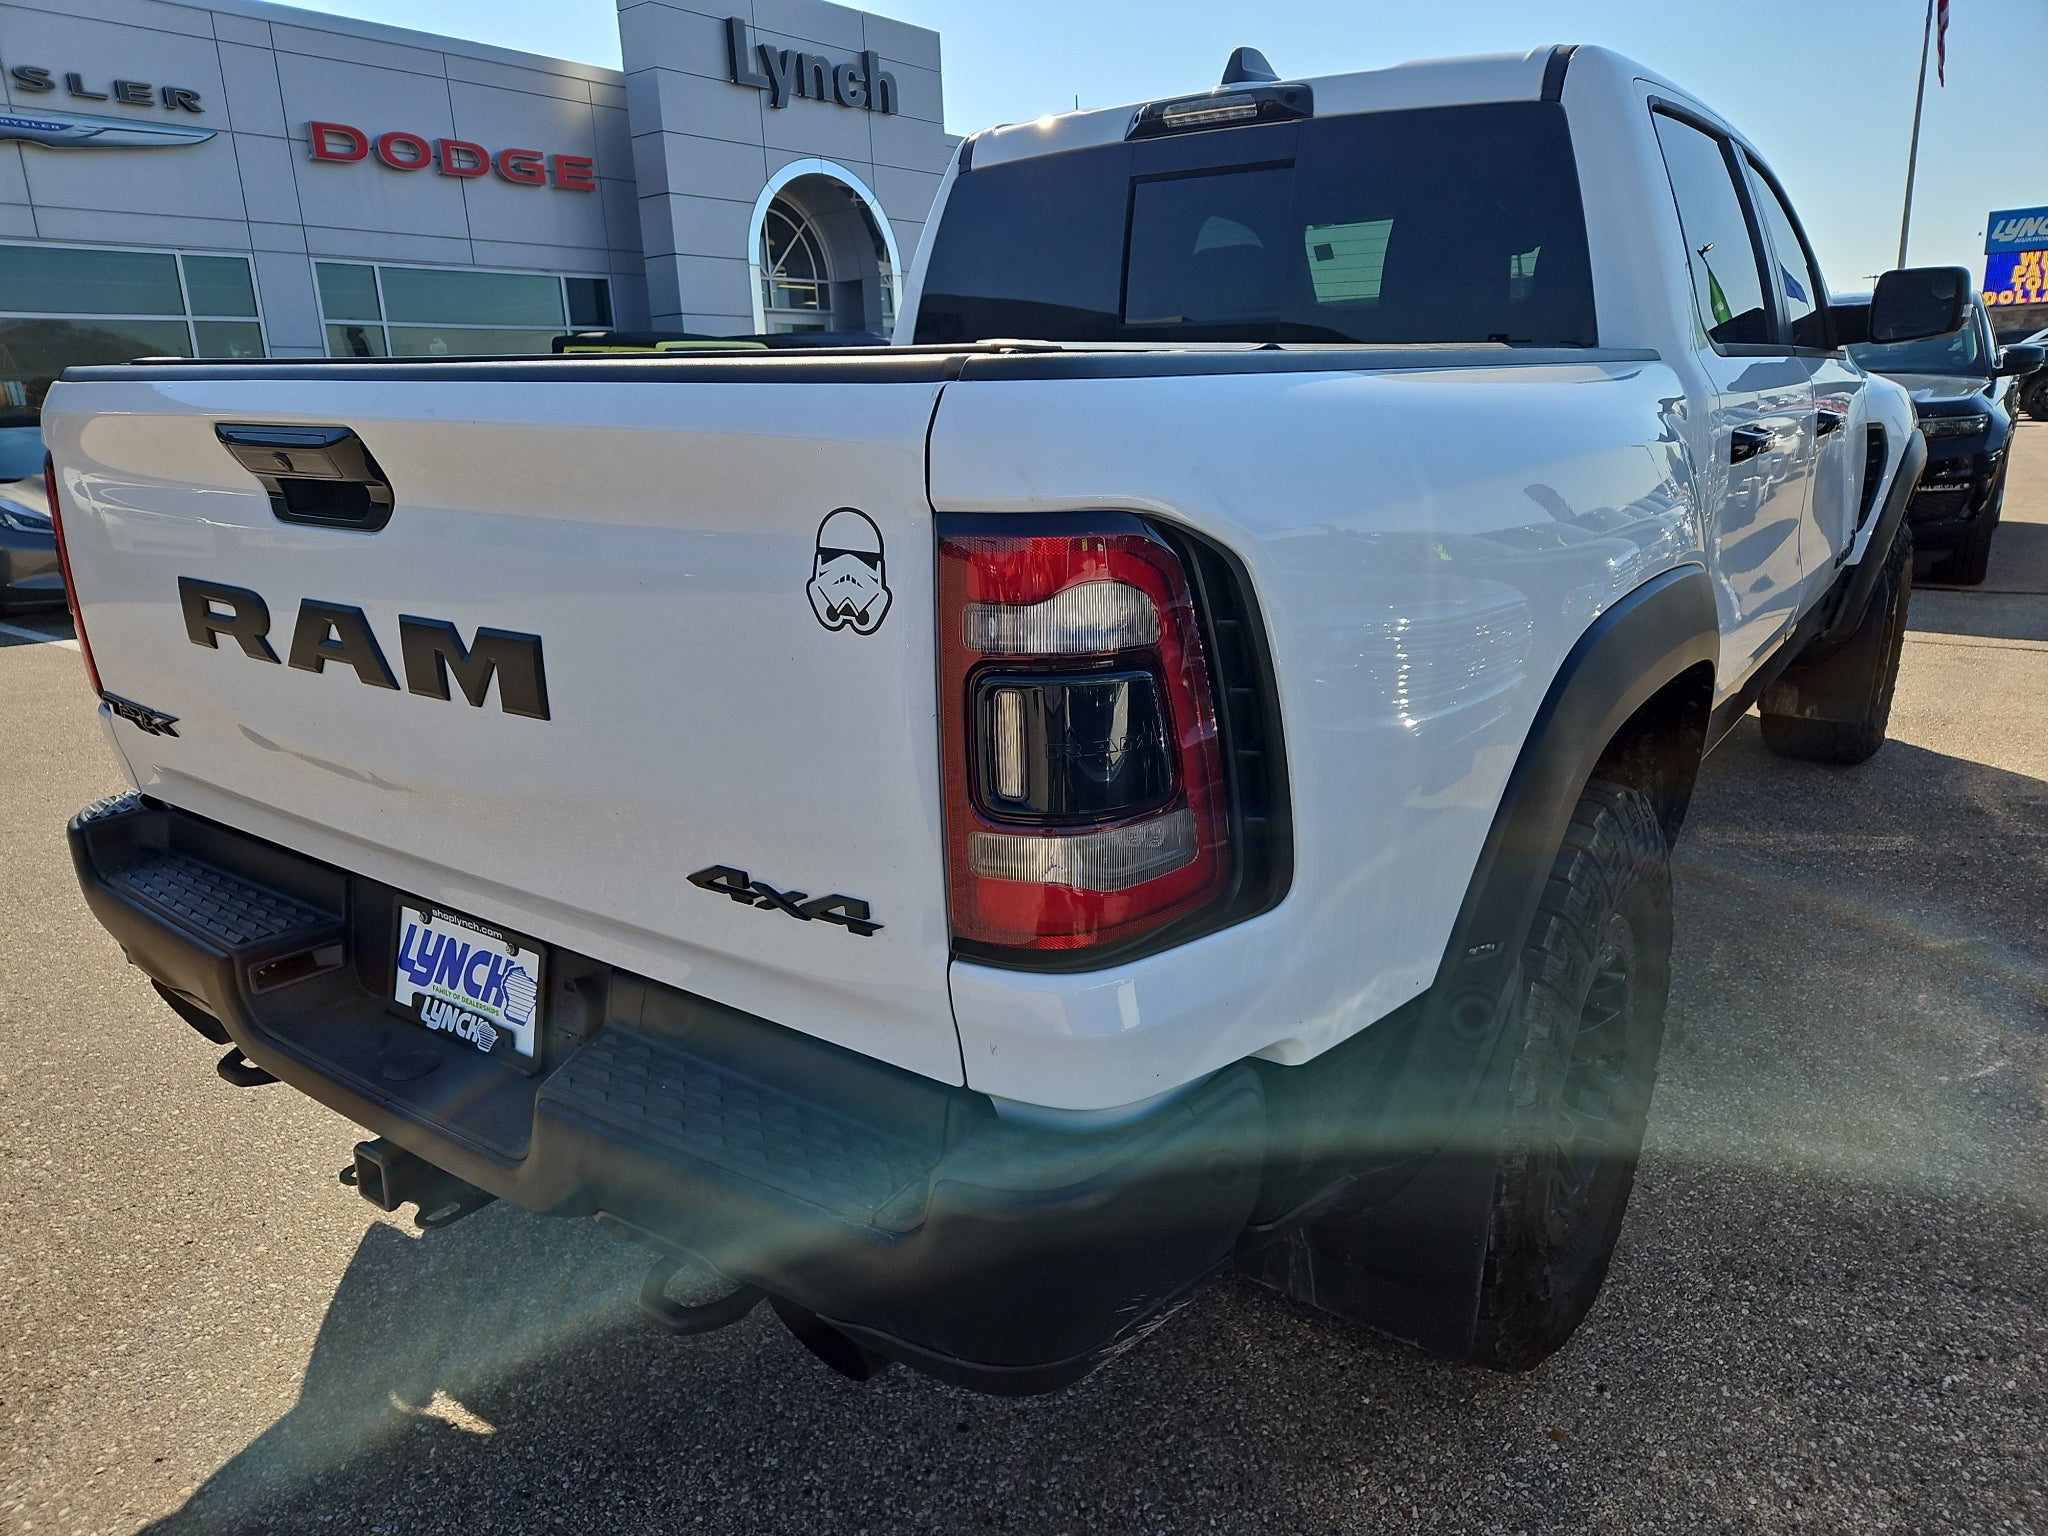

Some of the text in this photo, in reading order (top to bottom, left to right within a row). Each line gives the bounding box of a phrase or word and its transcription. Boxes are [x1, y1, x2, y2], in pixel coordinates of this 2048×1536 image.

[11, 64, 205, 113] SLER
[726, 16, 899, 115] Lynch
[306, 120, 596, 192] DODGE
[178, 575, 550, 721] RAM
[431, 908, 503, 940] shoplynch.com
[397, 923, 515, 1009] LYNCH
[420, 996, 484, 1044] LYNCH
[432, 985, 500, 1017] FAMILY OF DEALERSHIPS
